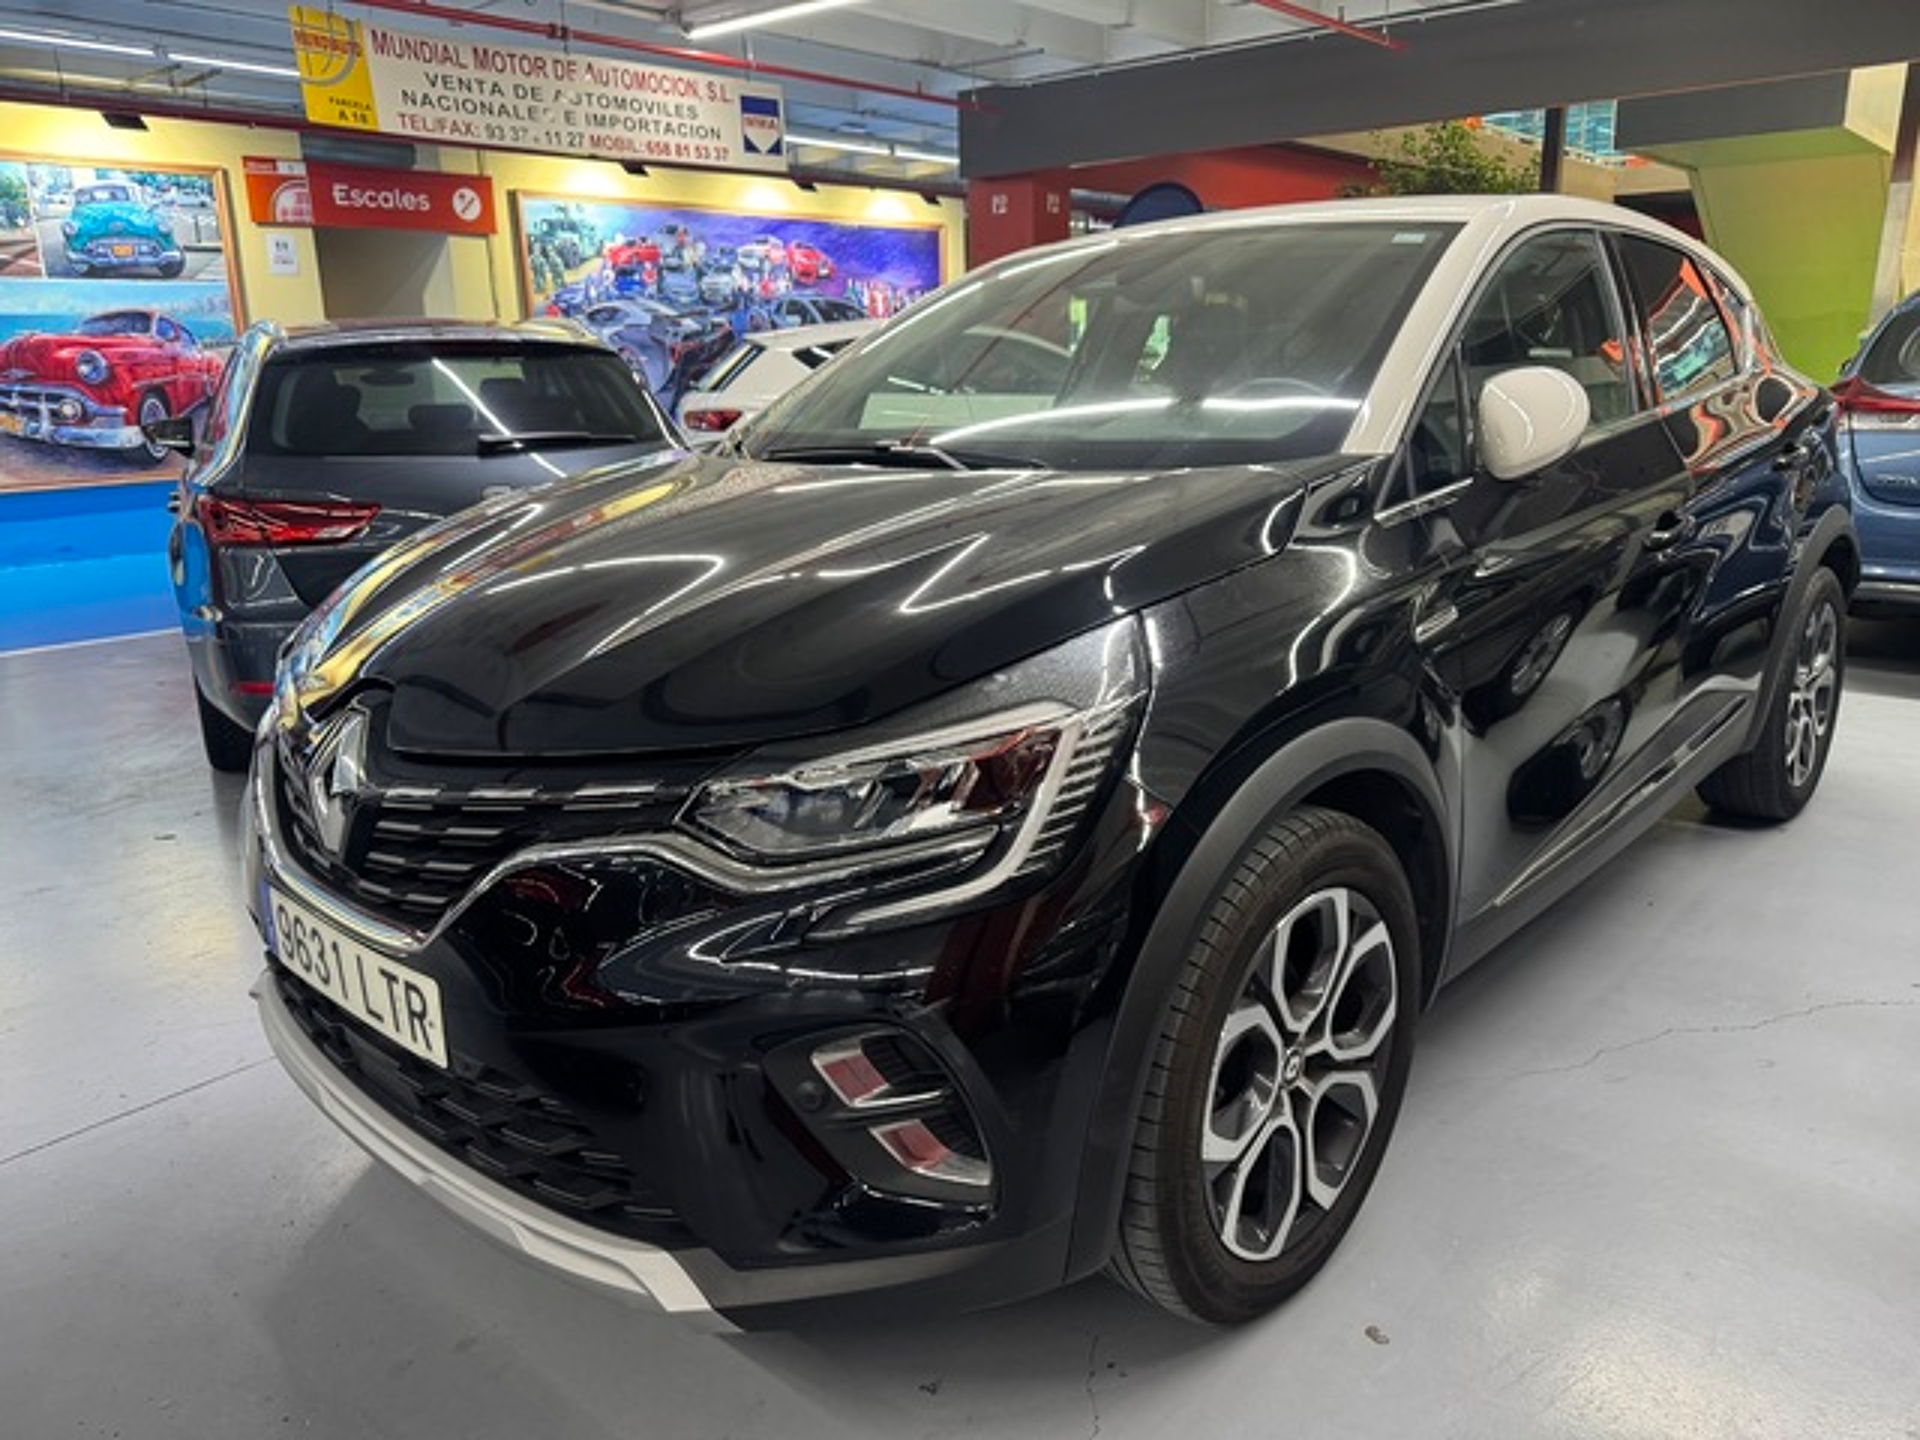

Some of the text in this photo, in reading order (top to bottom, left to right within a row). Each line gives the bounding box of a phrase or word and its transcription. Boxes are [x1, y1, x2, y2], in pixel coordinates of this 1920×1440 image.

[371, 29, 468, 69] MUNDIAL
[473, 46, 549, 79] MOTOR
[552, 58, 577, 81] DE
[423, 71, 504, 97] VENTA
[513, 84, 543, 102] DE
[563, 110, 577, 127] E
[584, 113, 721, 140] IMPORTACION
[332, 183, 430, 211] Escales
[277, 904, 433, 1051] 9631 LTR
